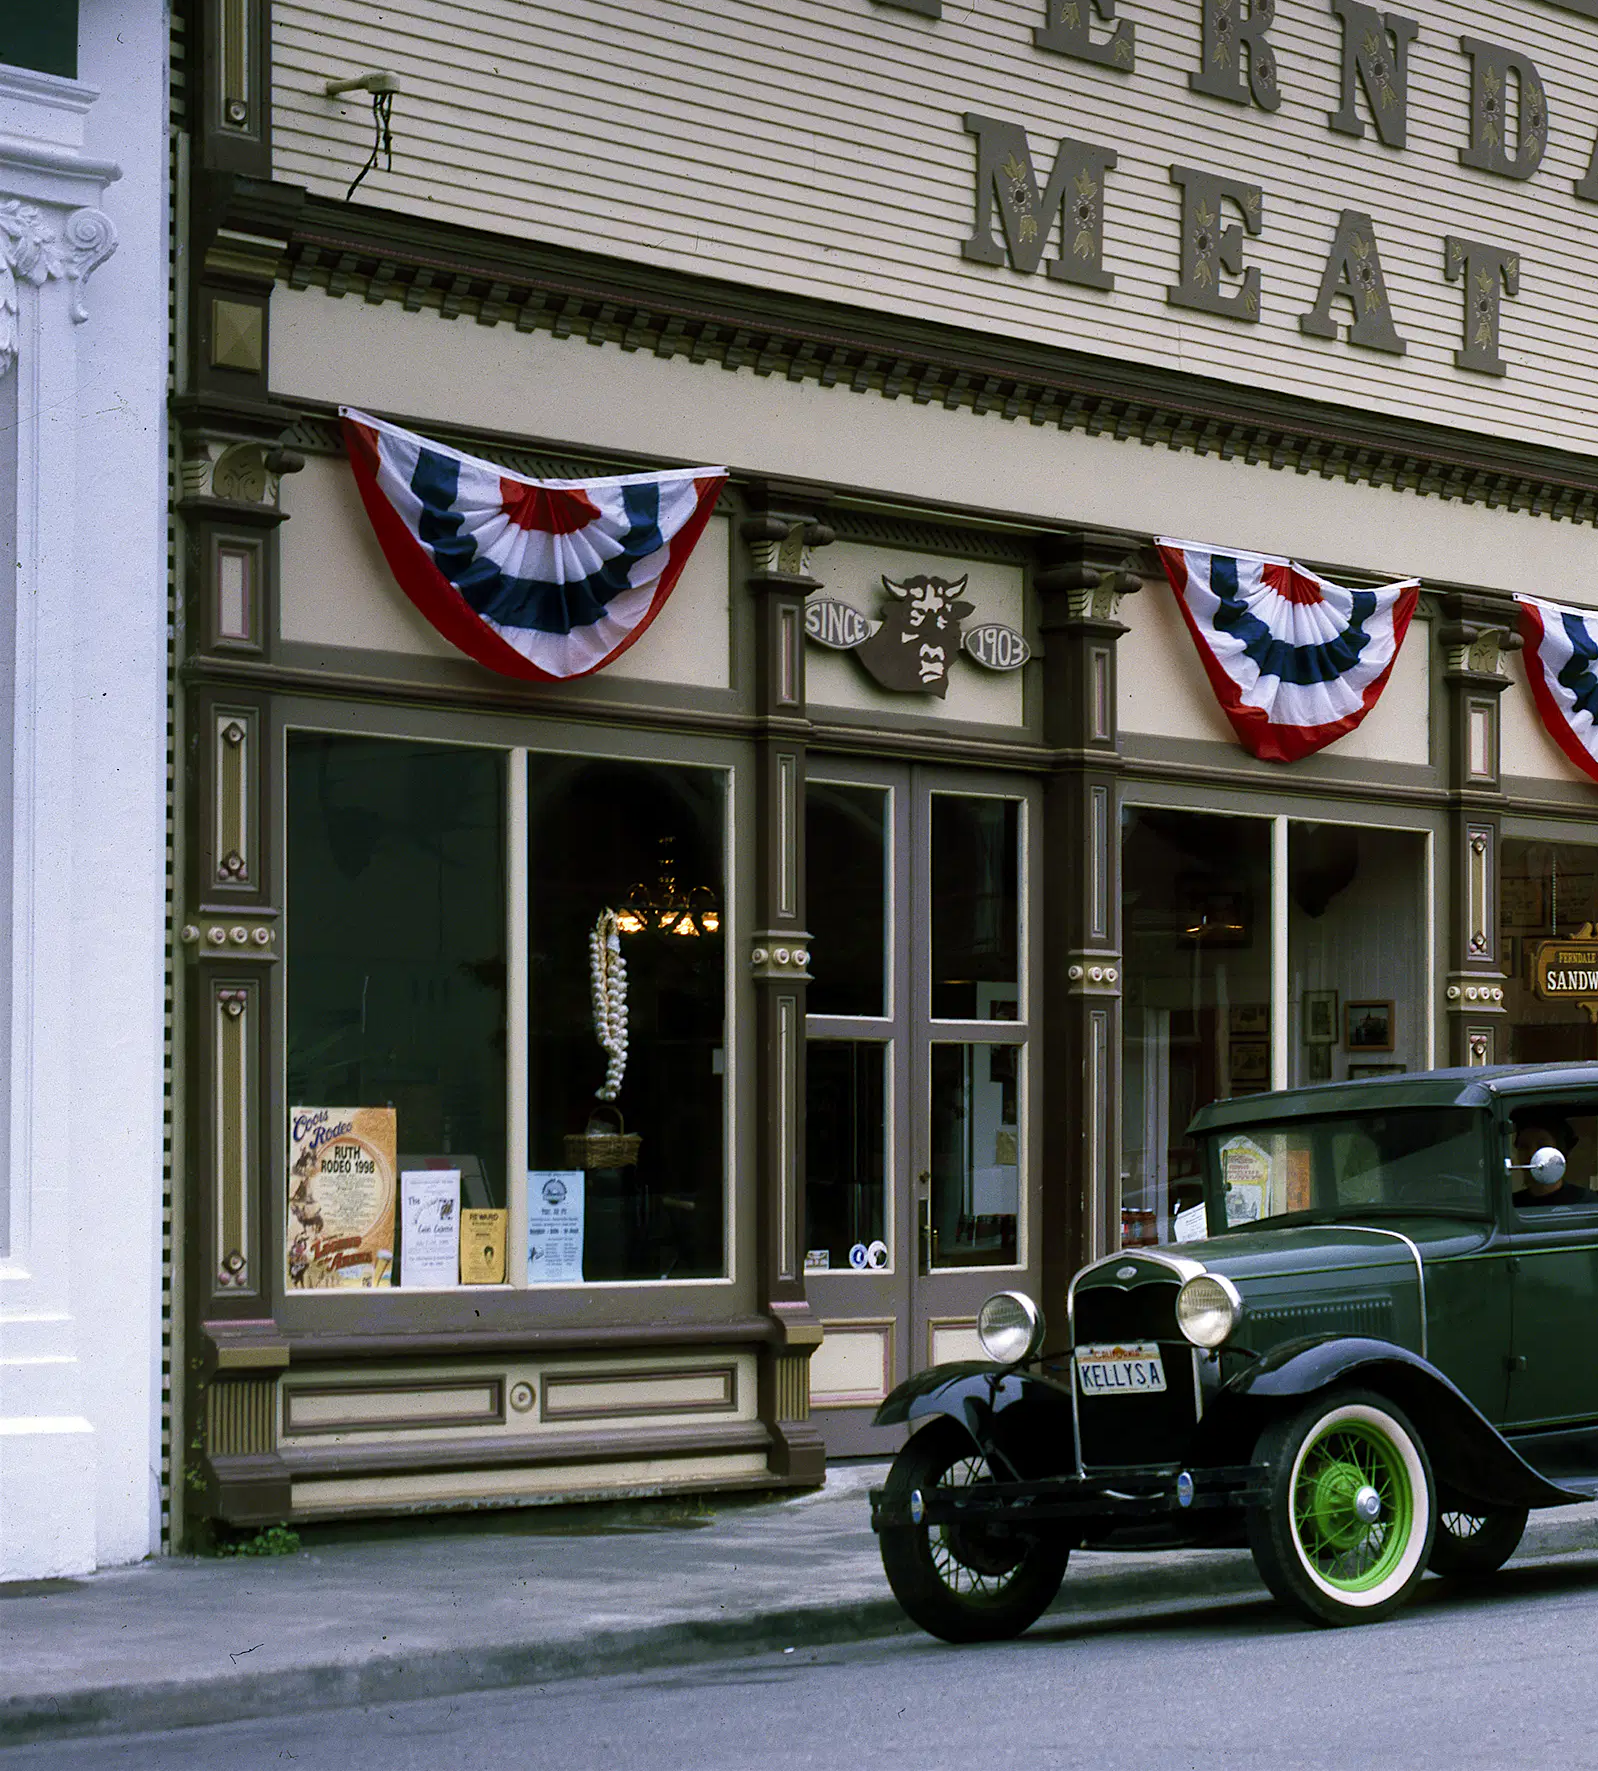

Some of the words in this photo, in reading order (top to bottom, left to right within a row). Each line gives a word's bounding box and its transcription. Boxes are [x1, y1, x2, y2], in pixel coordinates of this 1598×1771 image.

[961, 111, 1521, 378] MEAT
[805, 602, 866, 645] SINCE
[976, 628, 1025, 666] 1903
[1559, 952, 1596, 964] FERNDALE
[293, 1109, 329, 1142] Coors
[309, 1121, 353, 1149] Rodeo
[321, 1159, 352, 1174] RODEO
[355, 1160, 375, 1175] 1998
[334, 1145, 361, 1160] RUTH
